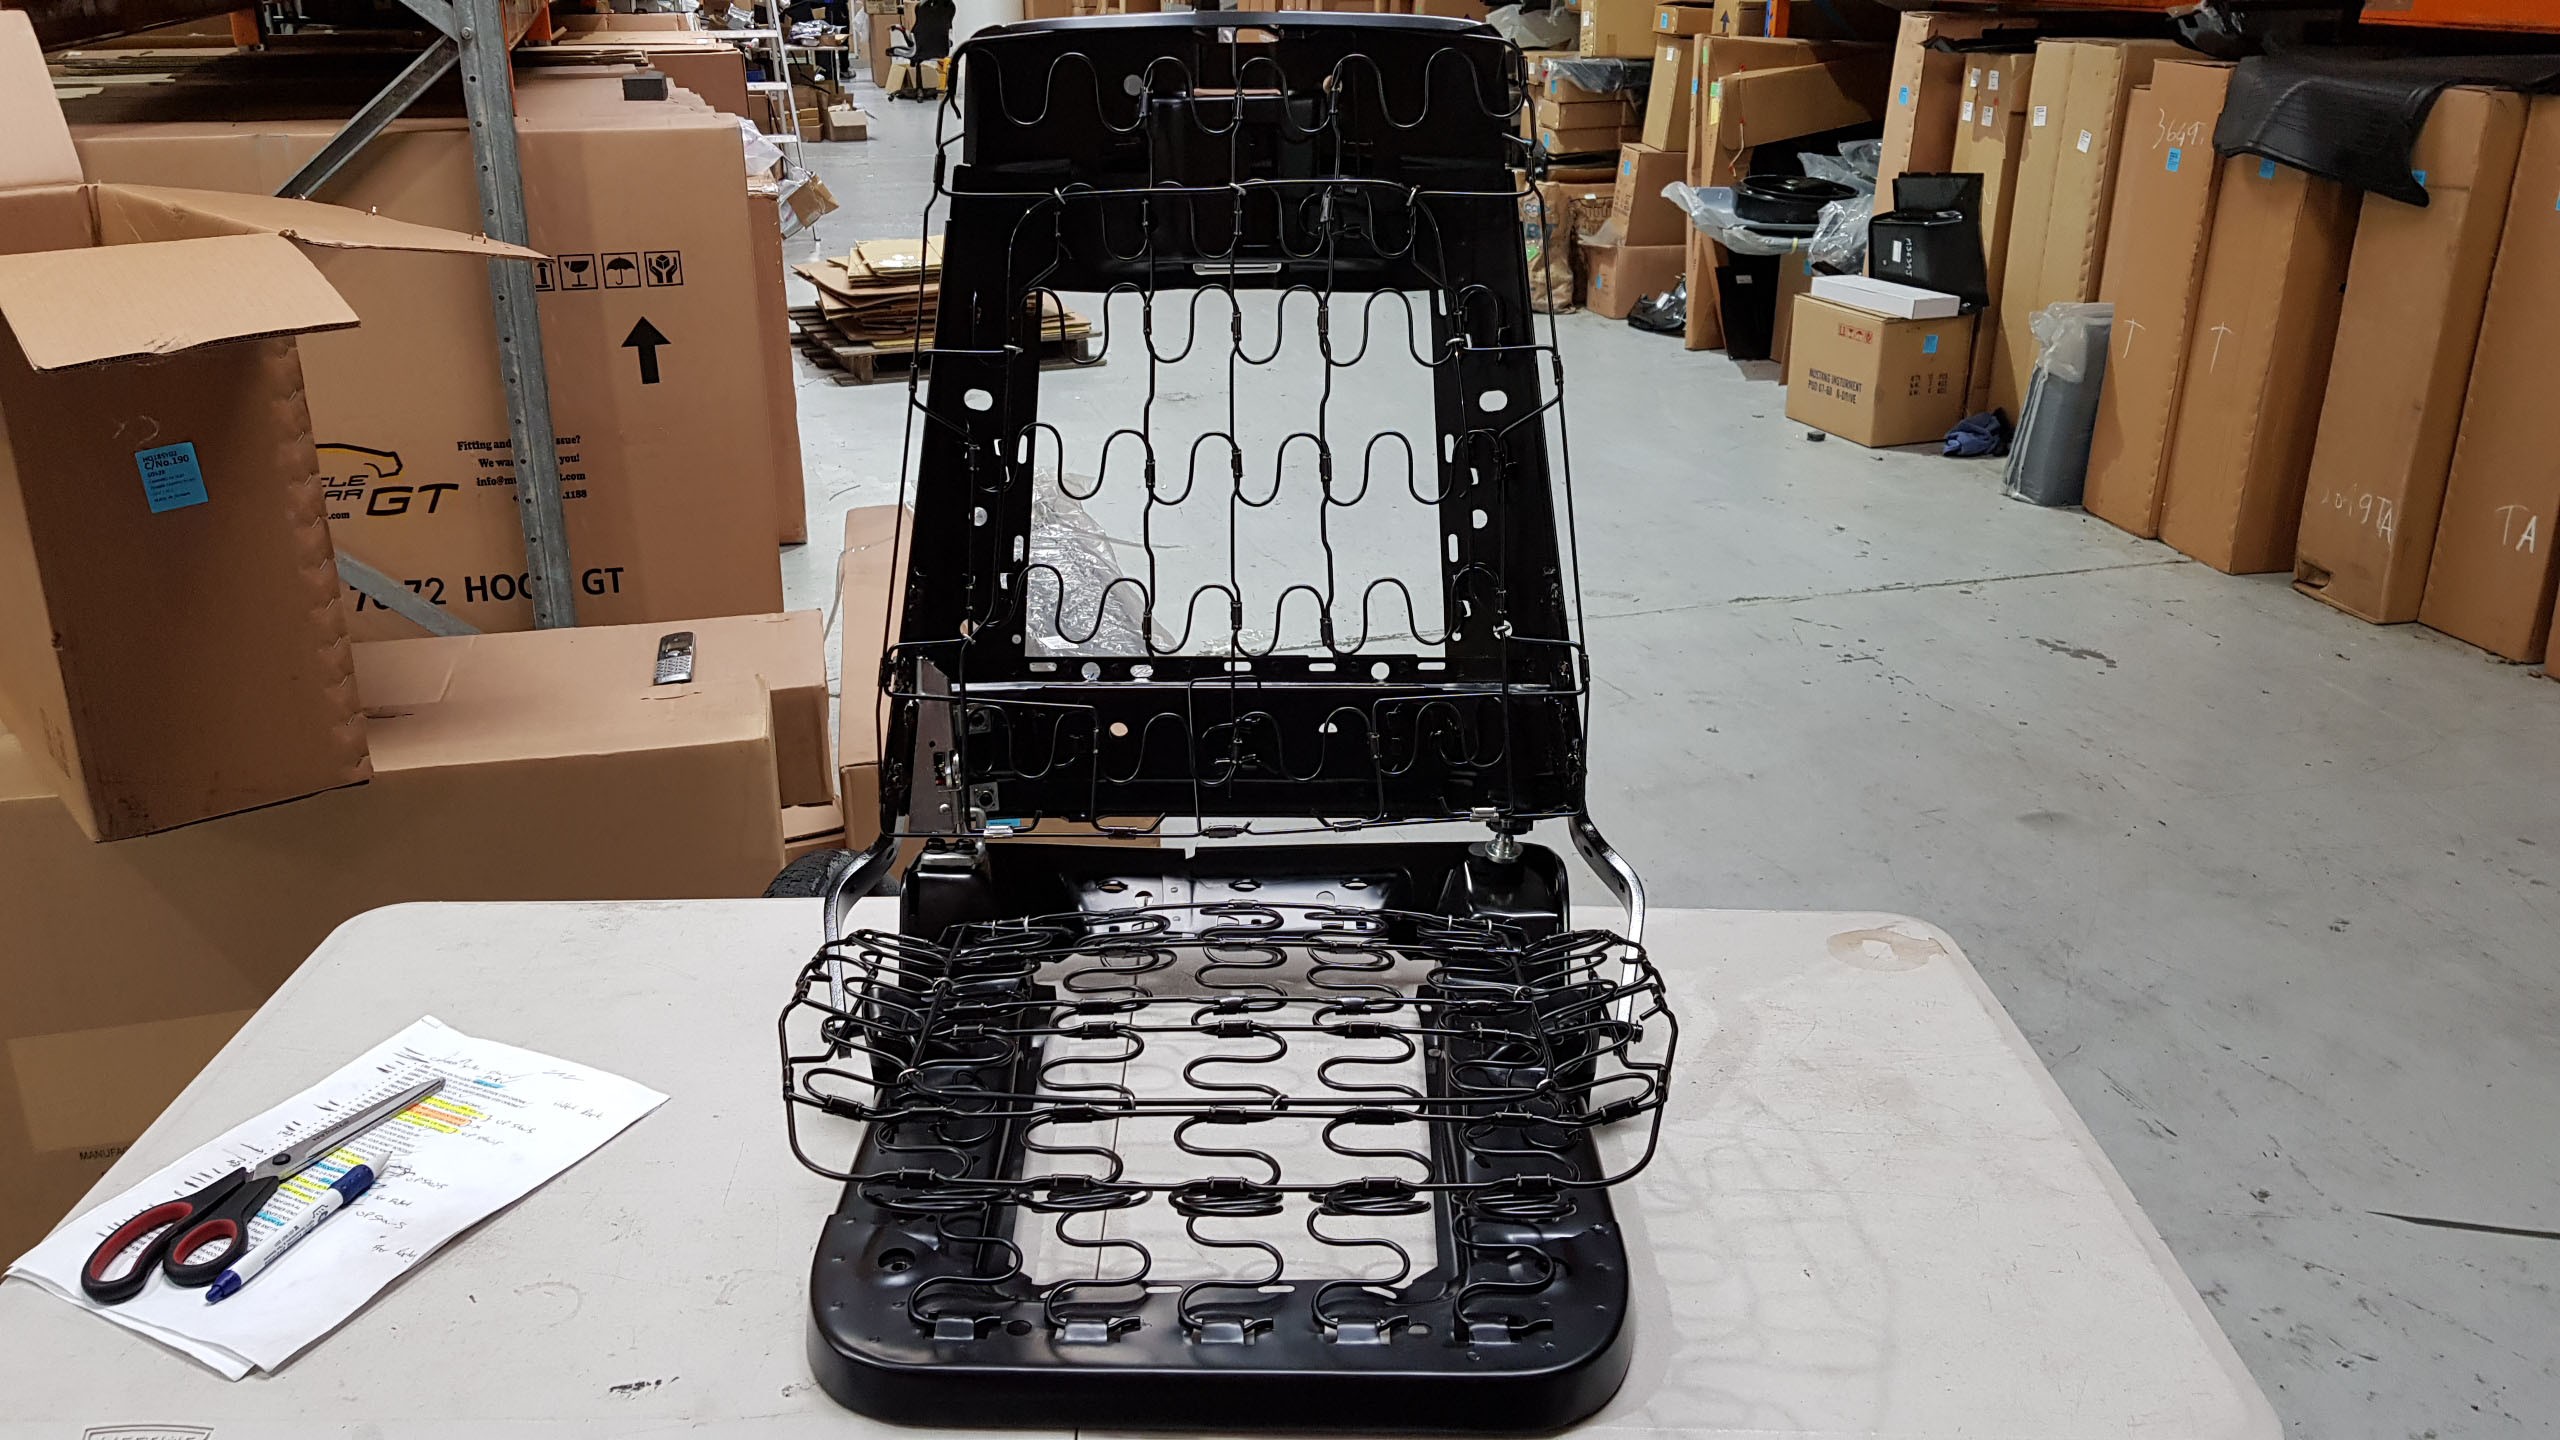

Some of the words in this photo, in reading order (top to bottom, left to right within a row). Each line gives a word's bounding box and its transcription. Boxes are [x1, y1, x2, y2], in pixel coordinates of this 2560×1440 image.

[457, 441, 492, 452] Fitting
[493, 438, 512, 450] and
[555, 435, 581, 446] ssue?
[144, 454, 190, 471] C/No.190
[478, 458, 493, 468] We
[559, 454, 580, 465] you!
[366, 483, 459, 516] GT
[582, 567, 624, 595] GT
